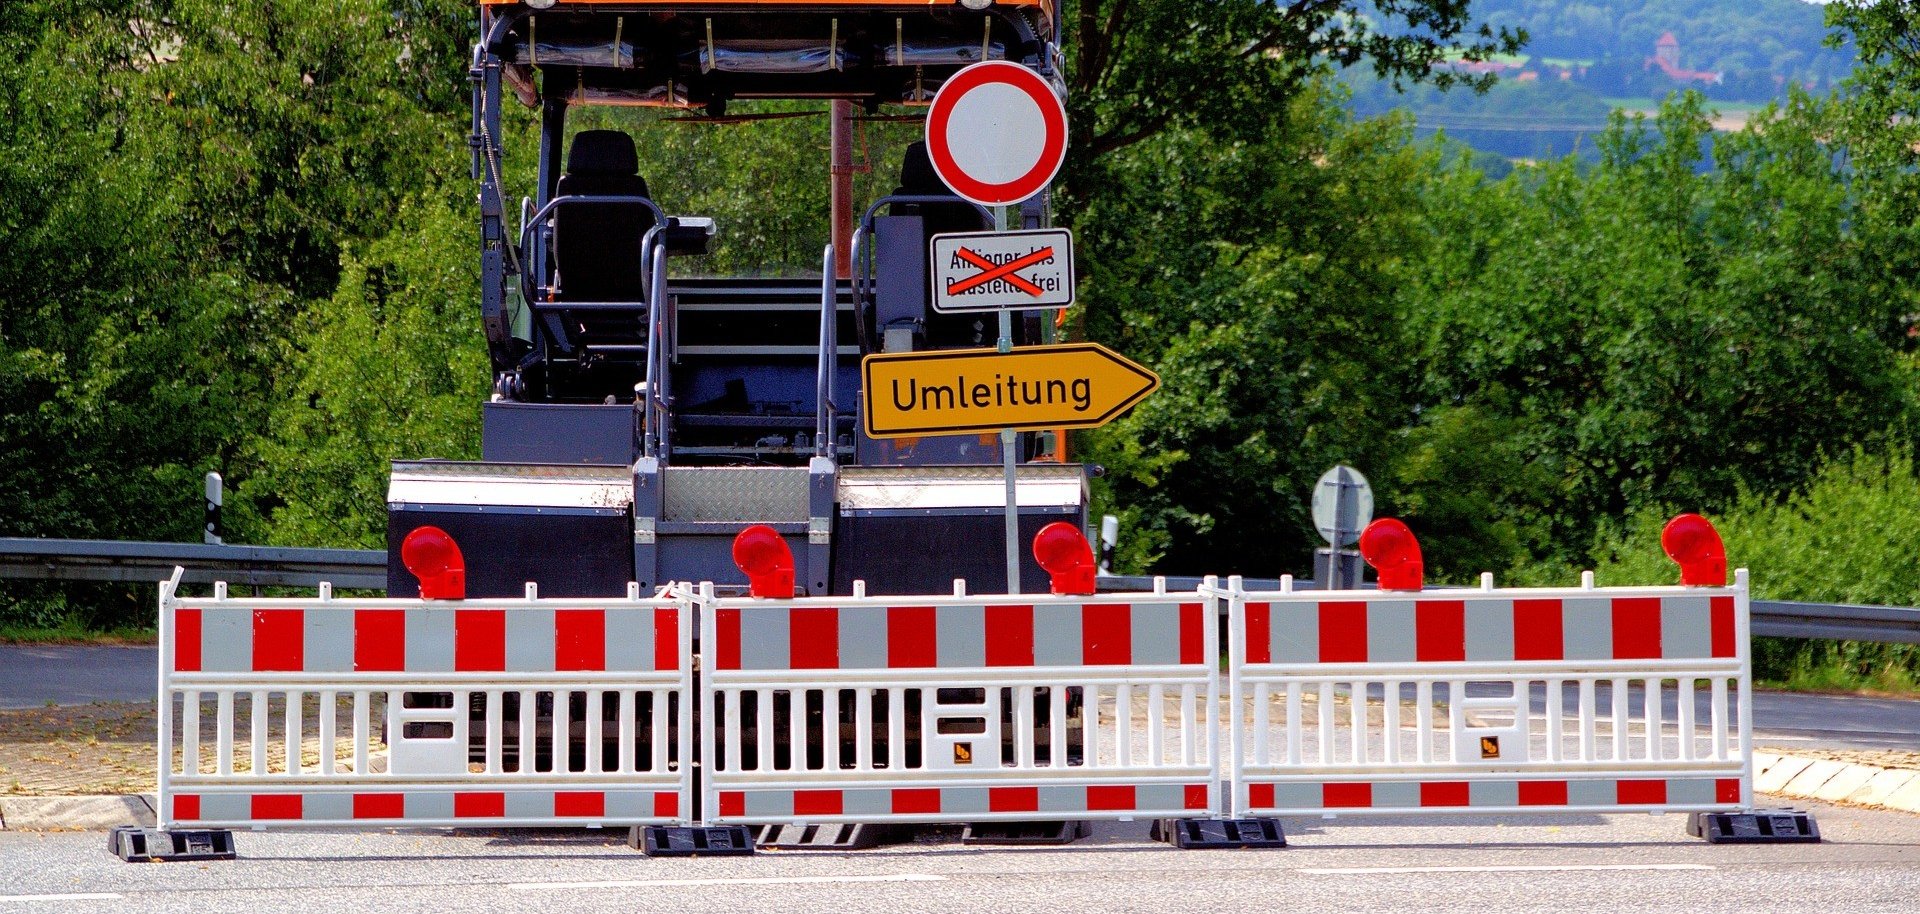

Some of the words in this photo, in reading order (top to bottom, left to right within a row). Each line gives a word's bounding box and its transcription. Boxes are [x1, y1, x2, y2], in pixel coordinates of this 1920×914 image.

[950, 248, 1021, 271] Aeger
[946, 276, 1025, 296] Bustel
[1031, 271, 1060, 291] frei
[892, 374, 1091, 412] Umleitung
